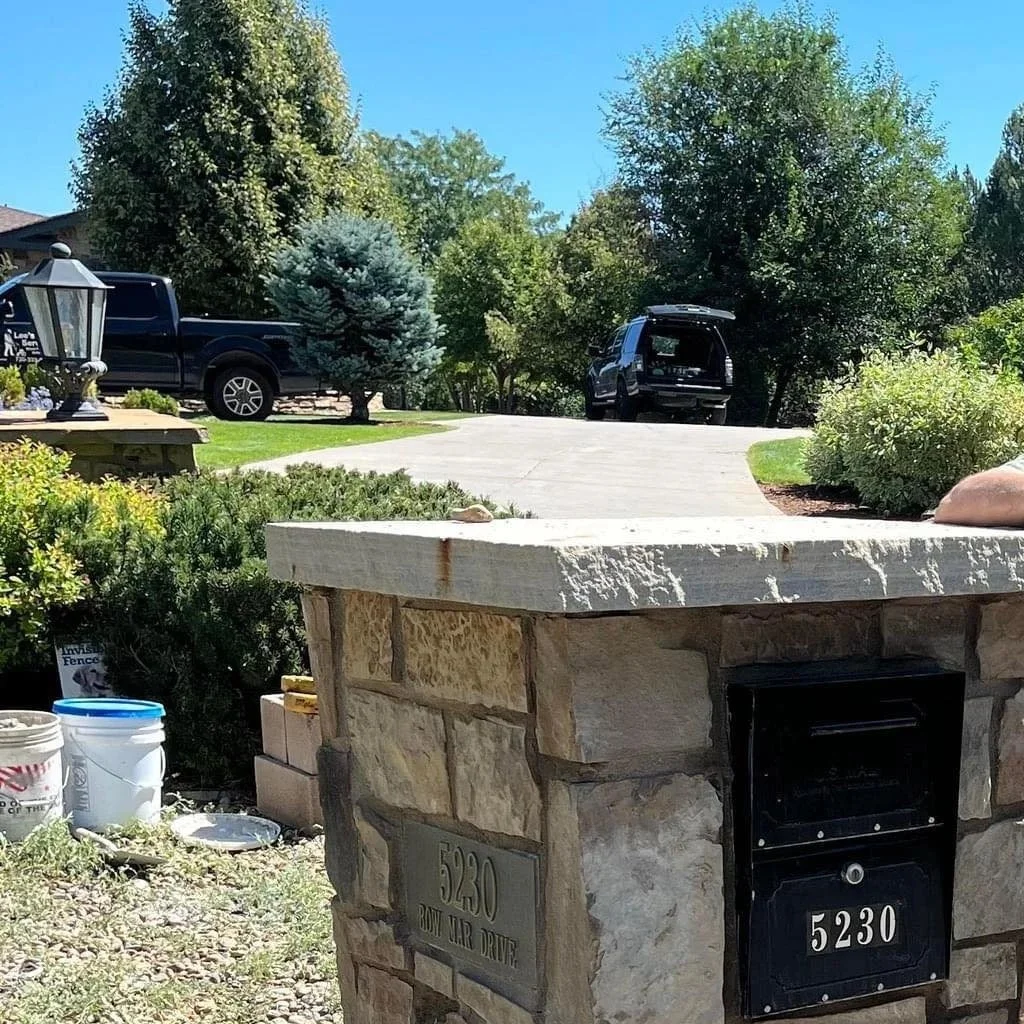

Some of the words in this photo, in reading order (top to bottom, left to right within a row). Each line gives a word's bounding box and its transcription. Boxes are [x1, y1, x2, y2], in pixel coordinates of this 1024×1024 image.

[63, 656, 99, 666] Fence
[439, 841, 498, 924] 5230
[480, 927, 518, 969] DRIVE
[811, 904, 896, 952] 5230
